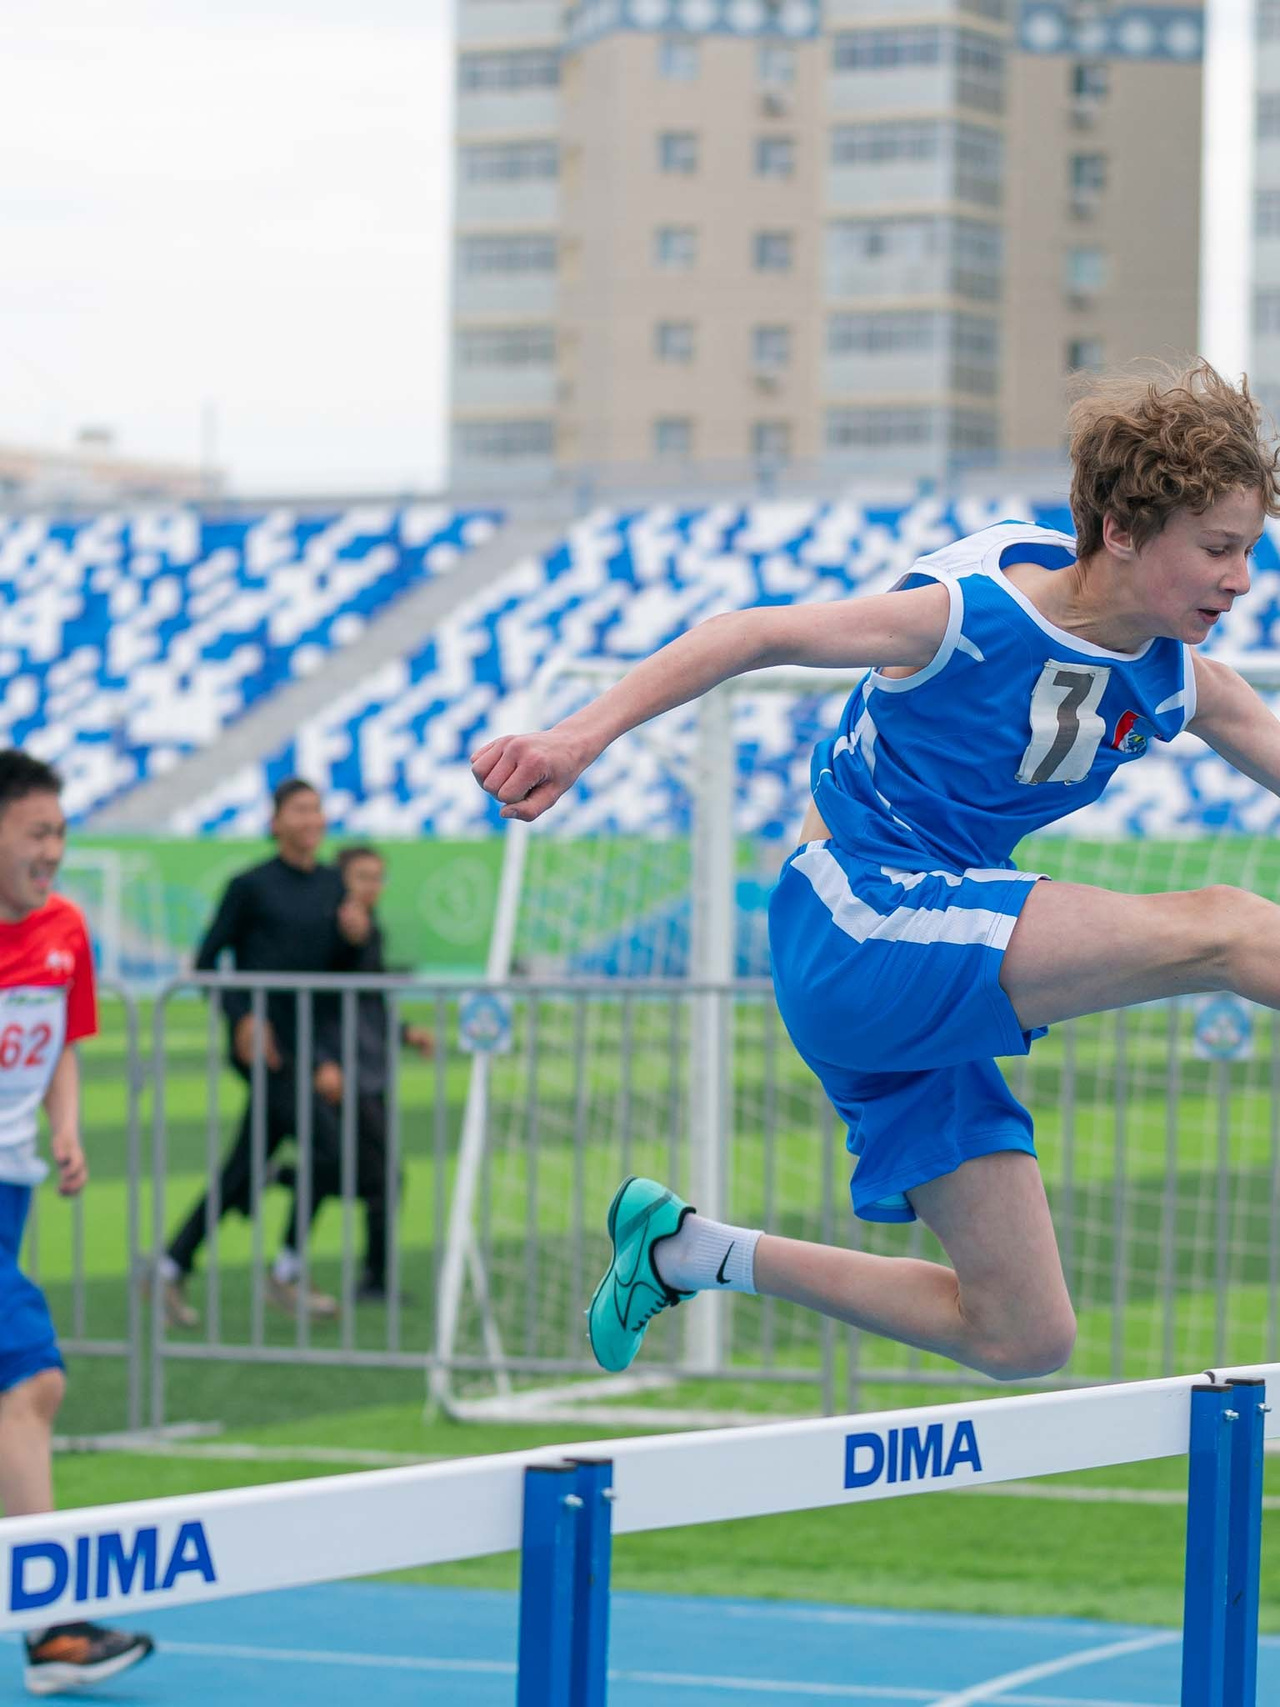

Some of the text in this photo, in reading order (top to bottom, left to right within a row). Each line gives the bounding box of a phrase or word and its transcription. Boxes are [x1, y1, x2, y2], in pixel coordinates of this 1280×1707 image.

[1031, 670, 1096, 783] 7
[0, 1022, 52, 1071] 62
[843, 1419, 984, 1490] DIMA
[8, 1519, 219, 1614] DIMA
